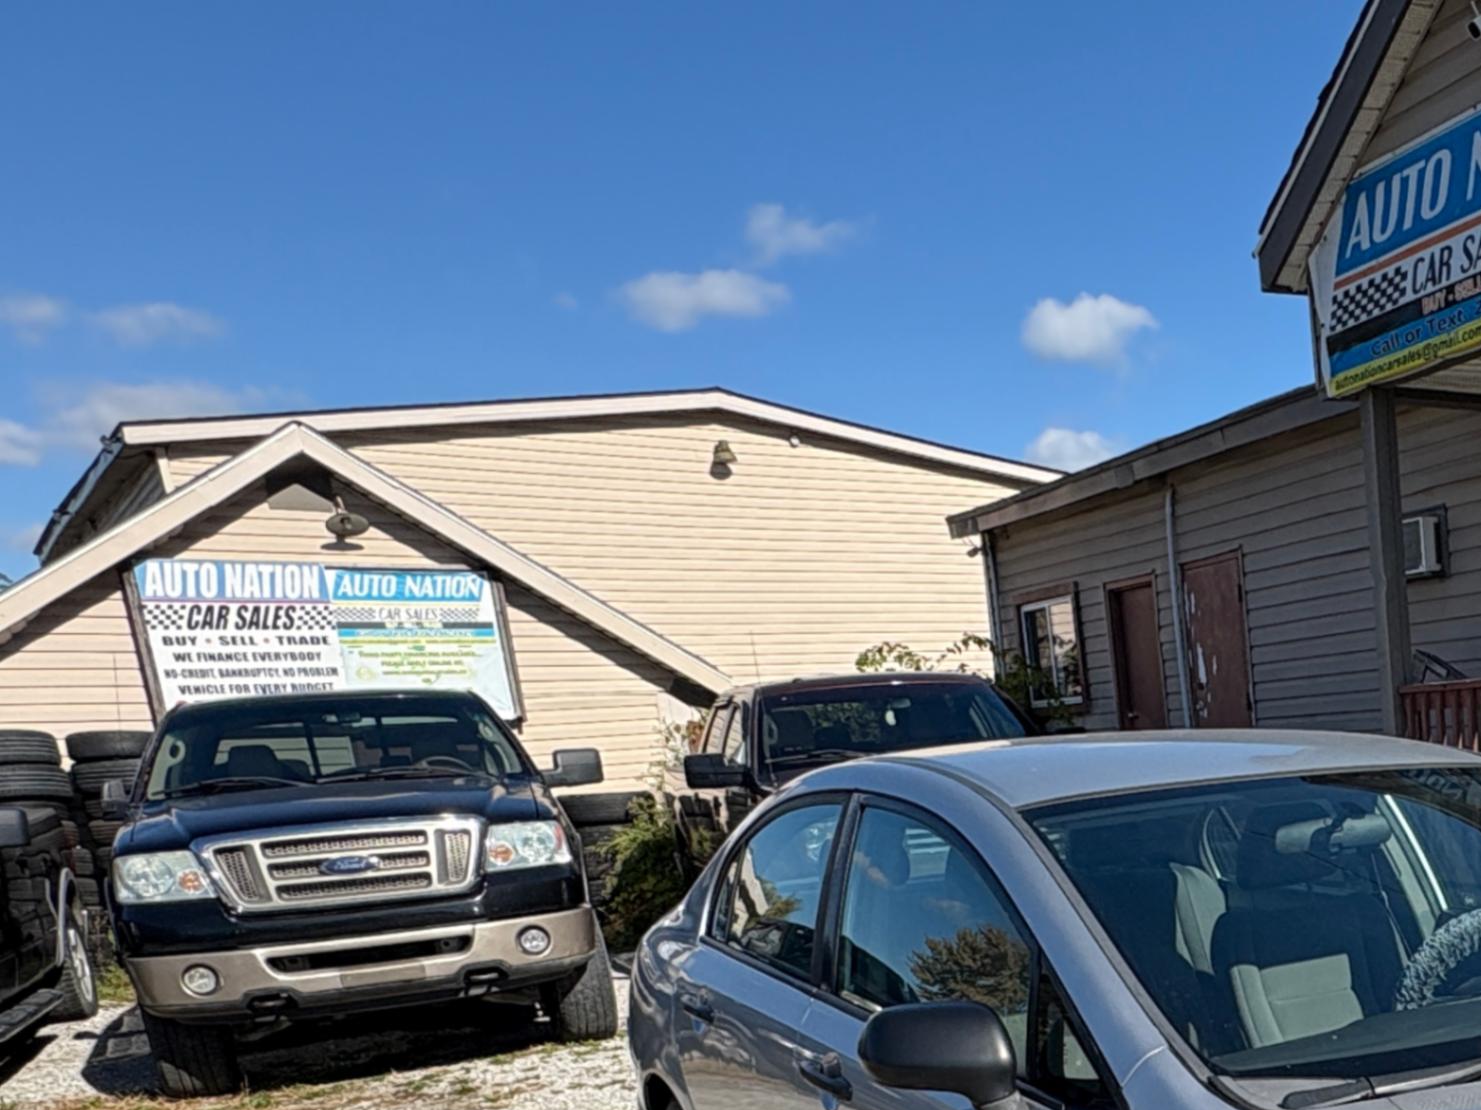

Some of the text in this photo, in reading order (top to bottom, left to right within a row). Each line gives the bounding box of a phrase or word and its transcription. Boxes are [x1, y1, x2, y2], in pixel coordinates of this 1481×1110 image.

[1345, 148, 1452, 259] AUTO
[1411, 246, 1453, 294] CAR
[1370, 336, 1399, 357] Call
[1404, 328, 1422, 344] or
[1426, 308, 1465, 333] Text
[145, 561, 321, 599] AUTO NATION
[337, 573, 480, 598] AUTO NATION
[187, 604, 297, 630] CAR SALES
[379, 607, 438, 619] CAR SALES
[162, 635, 197, 646] BUY
[218, 635, 258, 646] SELL
[275, 635, 331, 646] TRADE
[173, 651, 322, 663] WE FINANCE EVERYBODY
[282, 667, 296, 678] NO
[297, 666, 339, 677] PROBLEM
[178, 684, 226, 695] VEHICLE
[229, 683, 250, 694] FOR
[253, 683, 288, 694] EVERY
